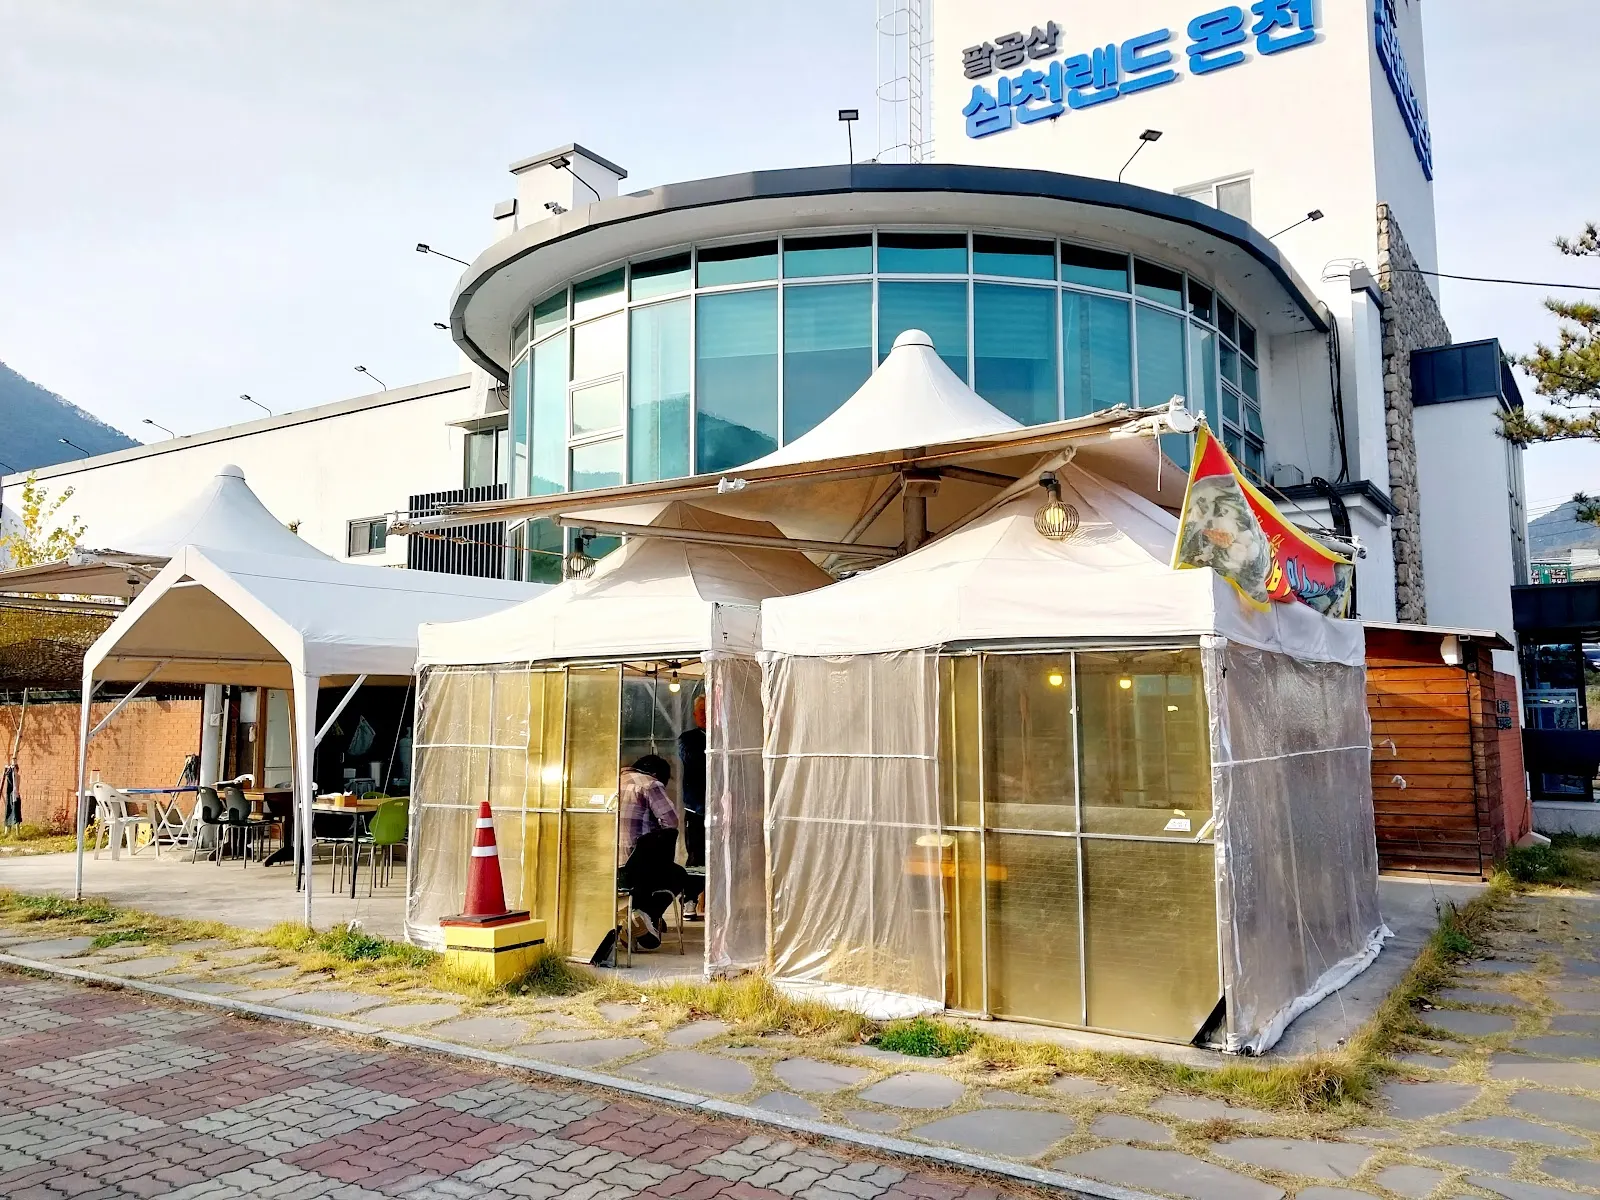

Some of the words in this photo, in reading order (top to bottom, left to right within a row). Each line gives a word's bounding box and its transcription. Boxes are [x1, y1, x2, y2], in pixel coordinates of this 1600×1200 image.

[962, 20, 1060, 79] 팔공산
[962, 28, 1179, 138] 심천랜드
[1186, 0, 1317, 75] 온천
